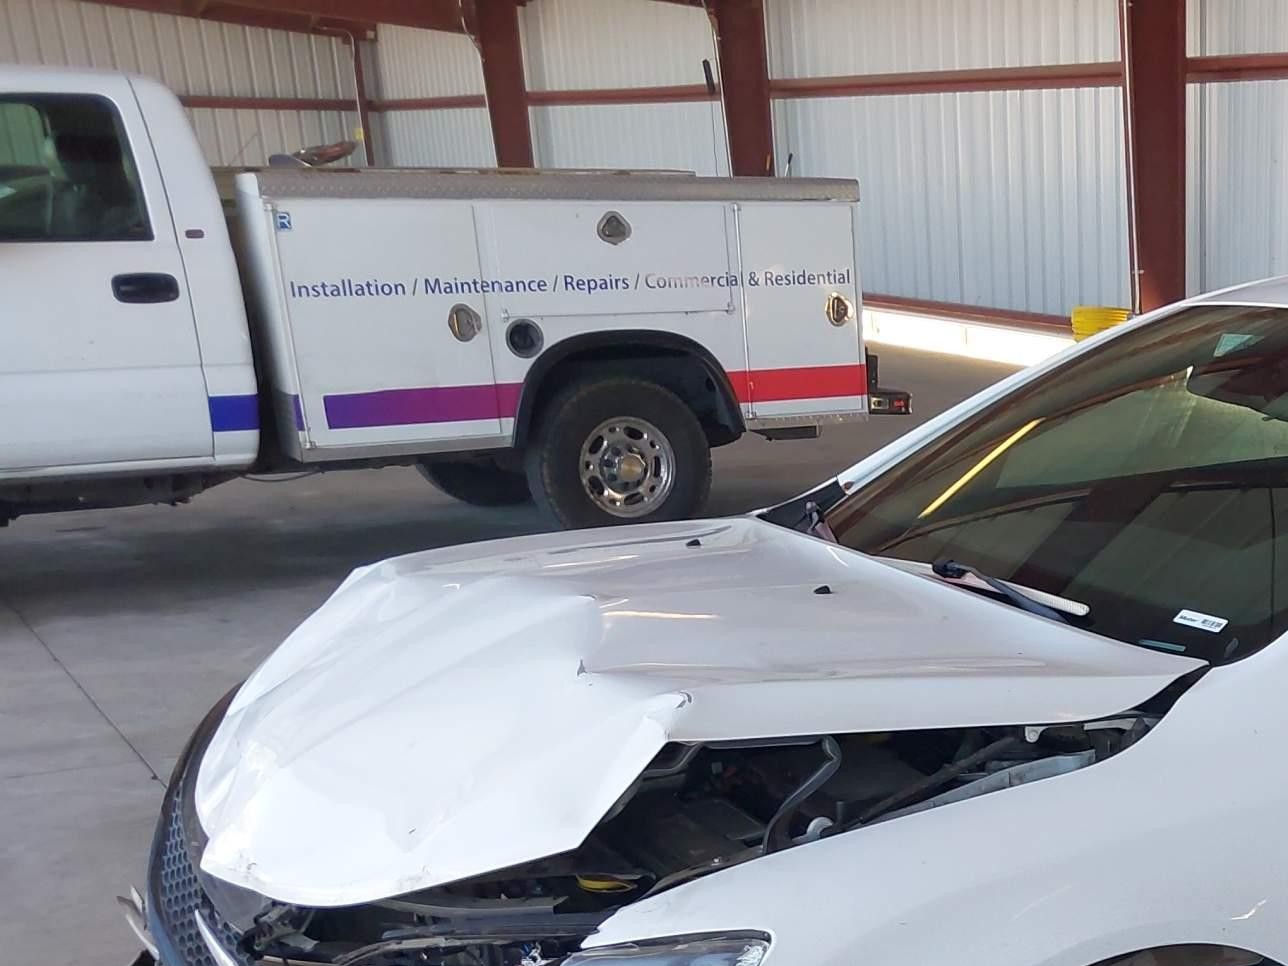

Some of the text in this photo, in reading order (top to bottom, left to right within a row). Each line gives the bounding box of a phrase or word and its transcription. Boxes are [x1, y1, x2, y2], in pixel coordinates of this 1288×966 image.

[290, 268, 851, 298] Installation / Maintenance / Repairs / Commercial & Residential
